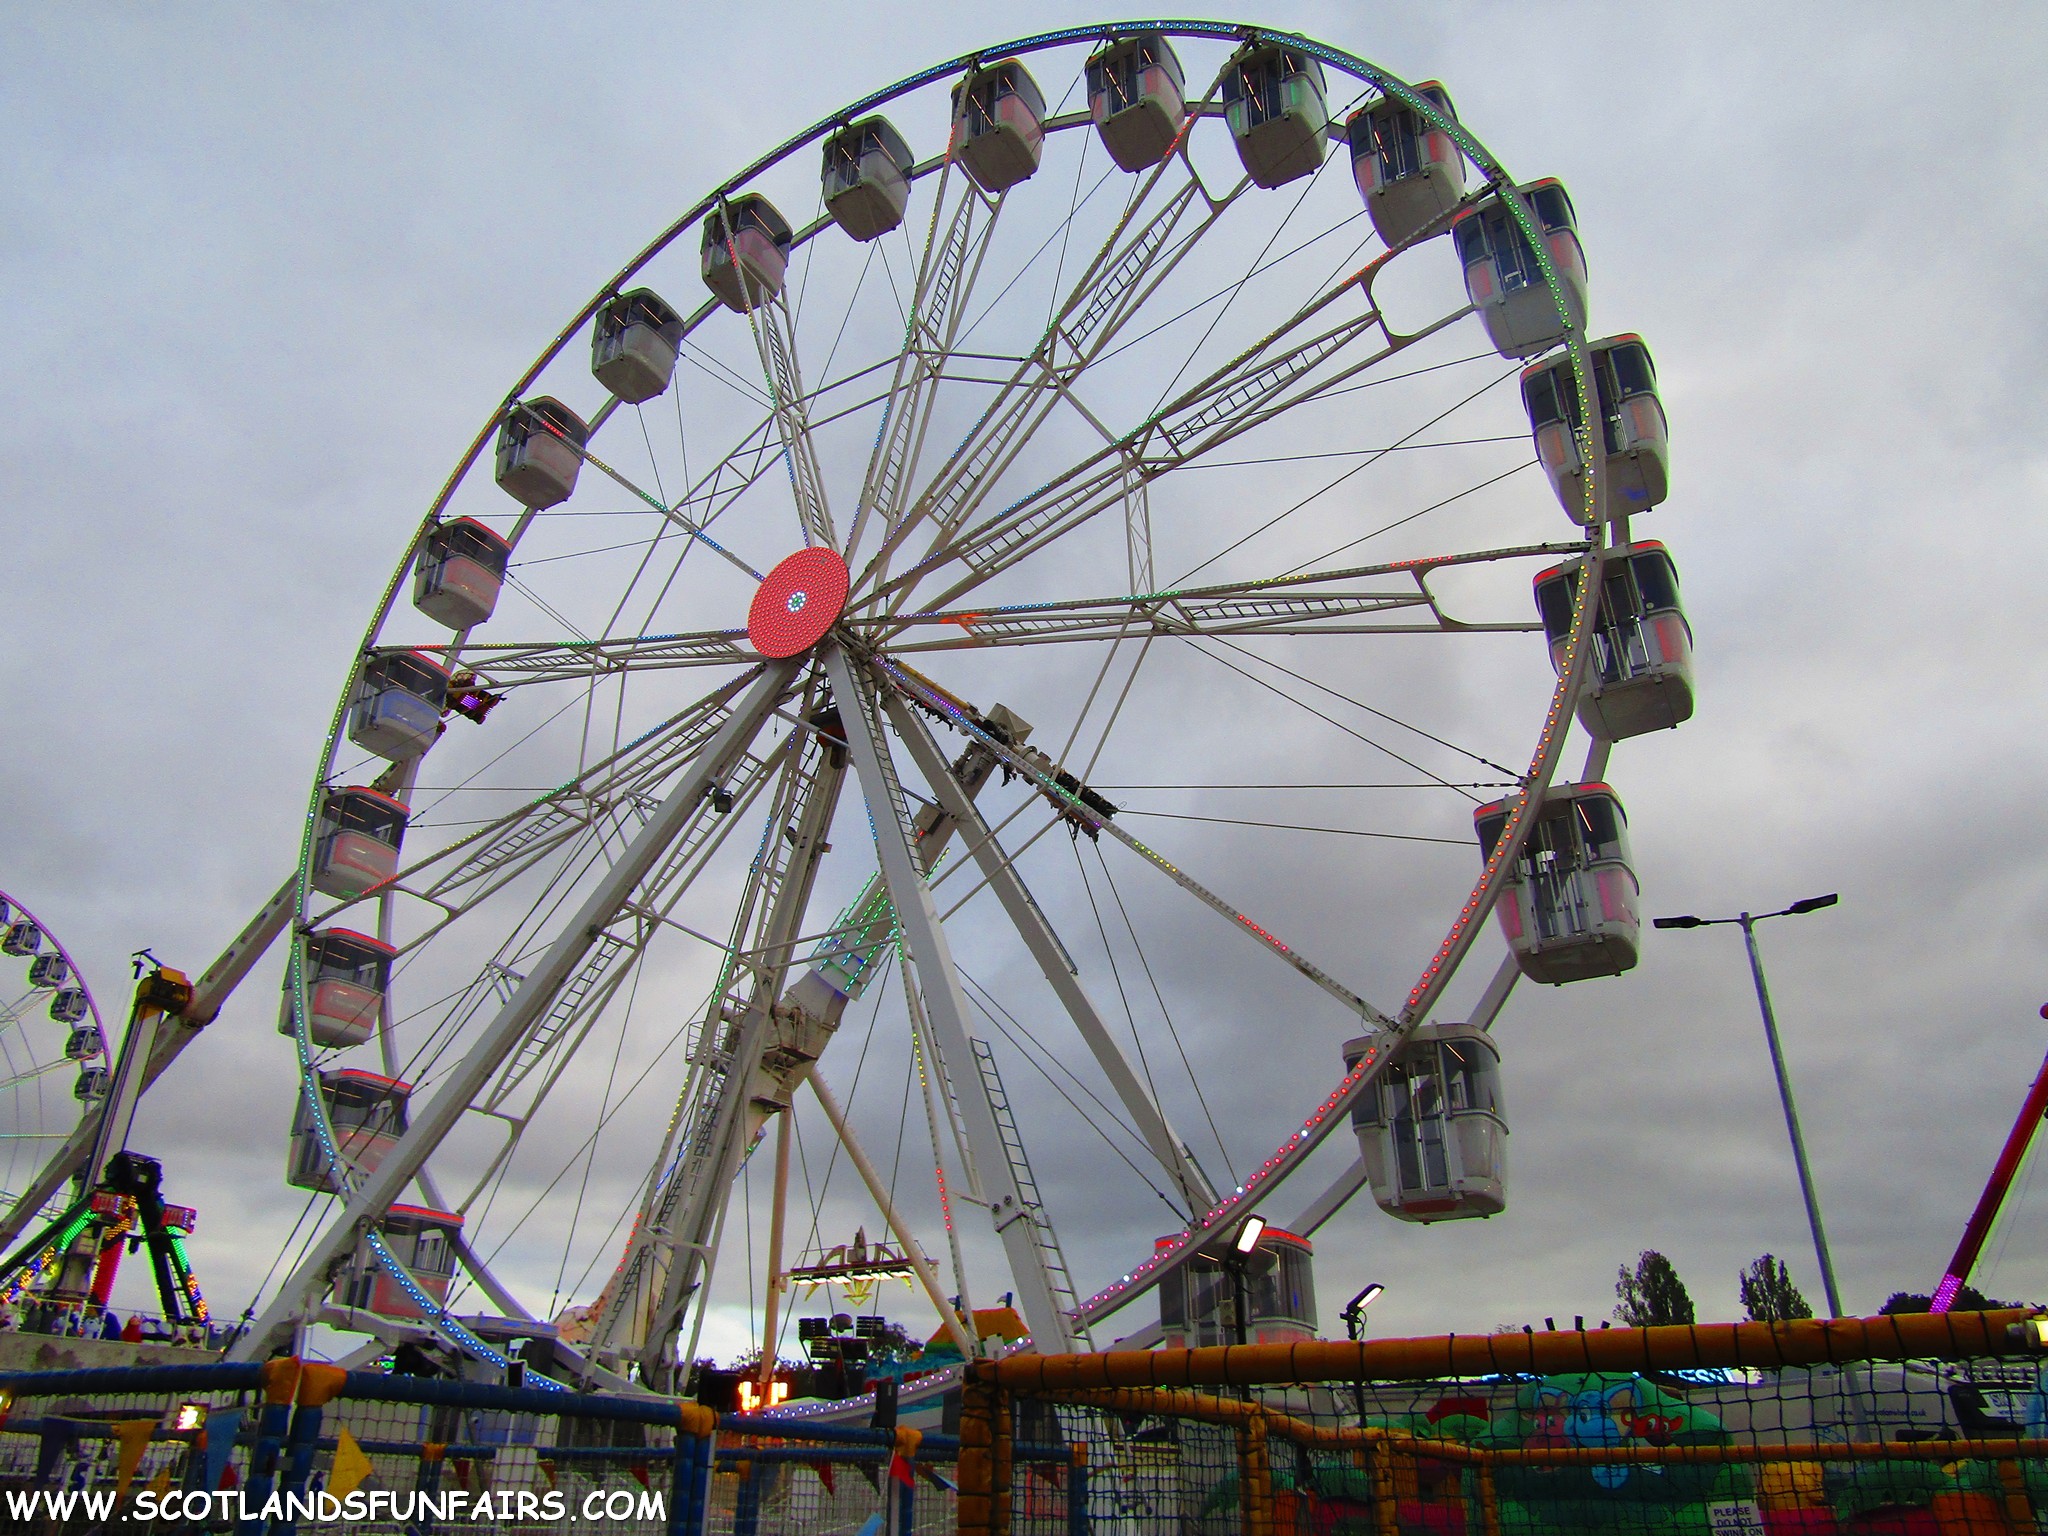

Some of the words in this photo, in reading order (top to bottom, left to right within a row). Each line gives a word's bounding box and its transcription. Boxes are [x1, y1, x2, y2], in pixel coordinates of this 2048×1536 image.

[1713, 1506, 1751, 1517] PLEASE
[1717, 1518, 1731, 1527] DO
[1732, 1517, 1753, 1527] NOT
[1748, 1527, 1763, 1536] ON
